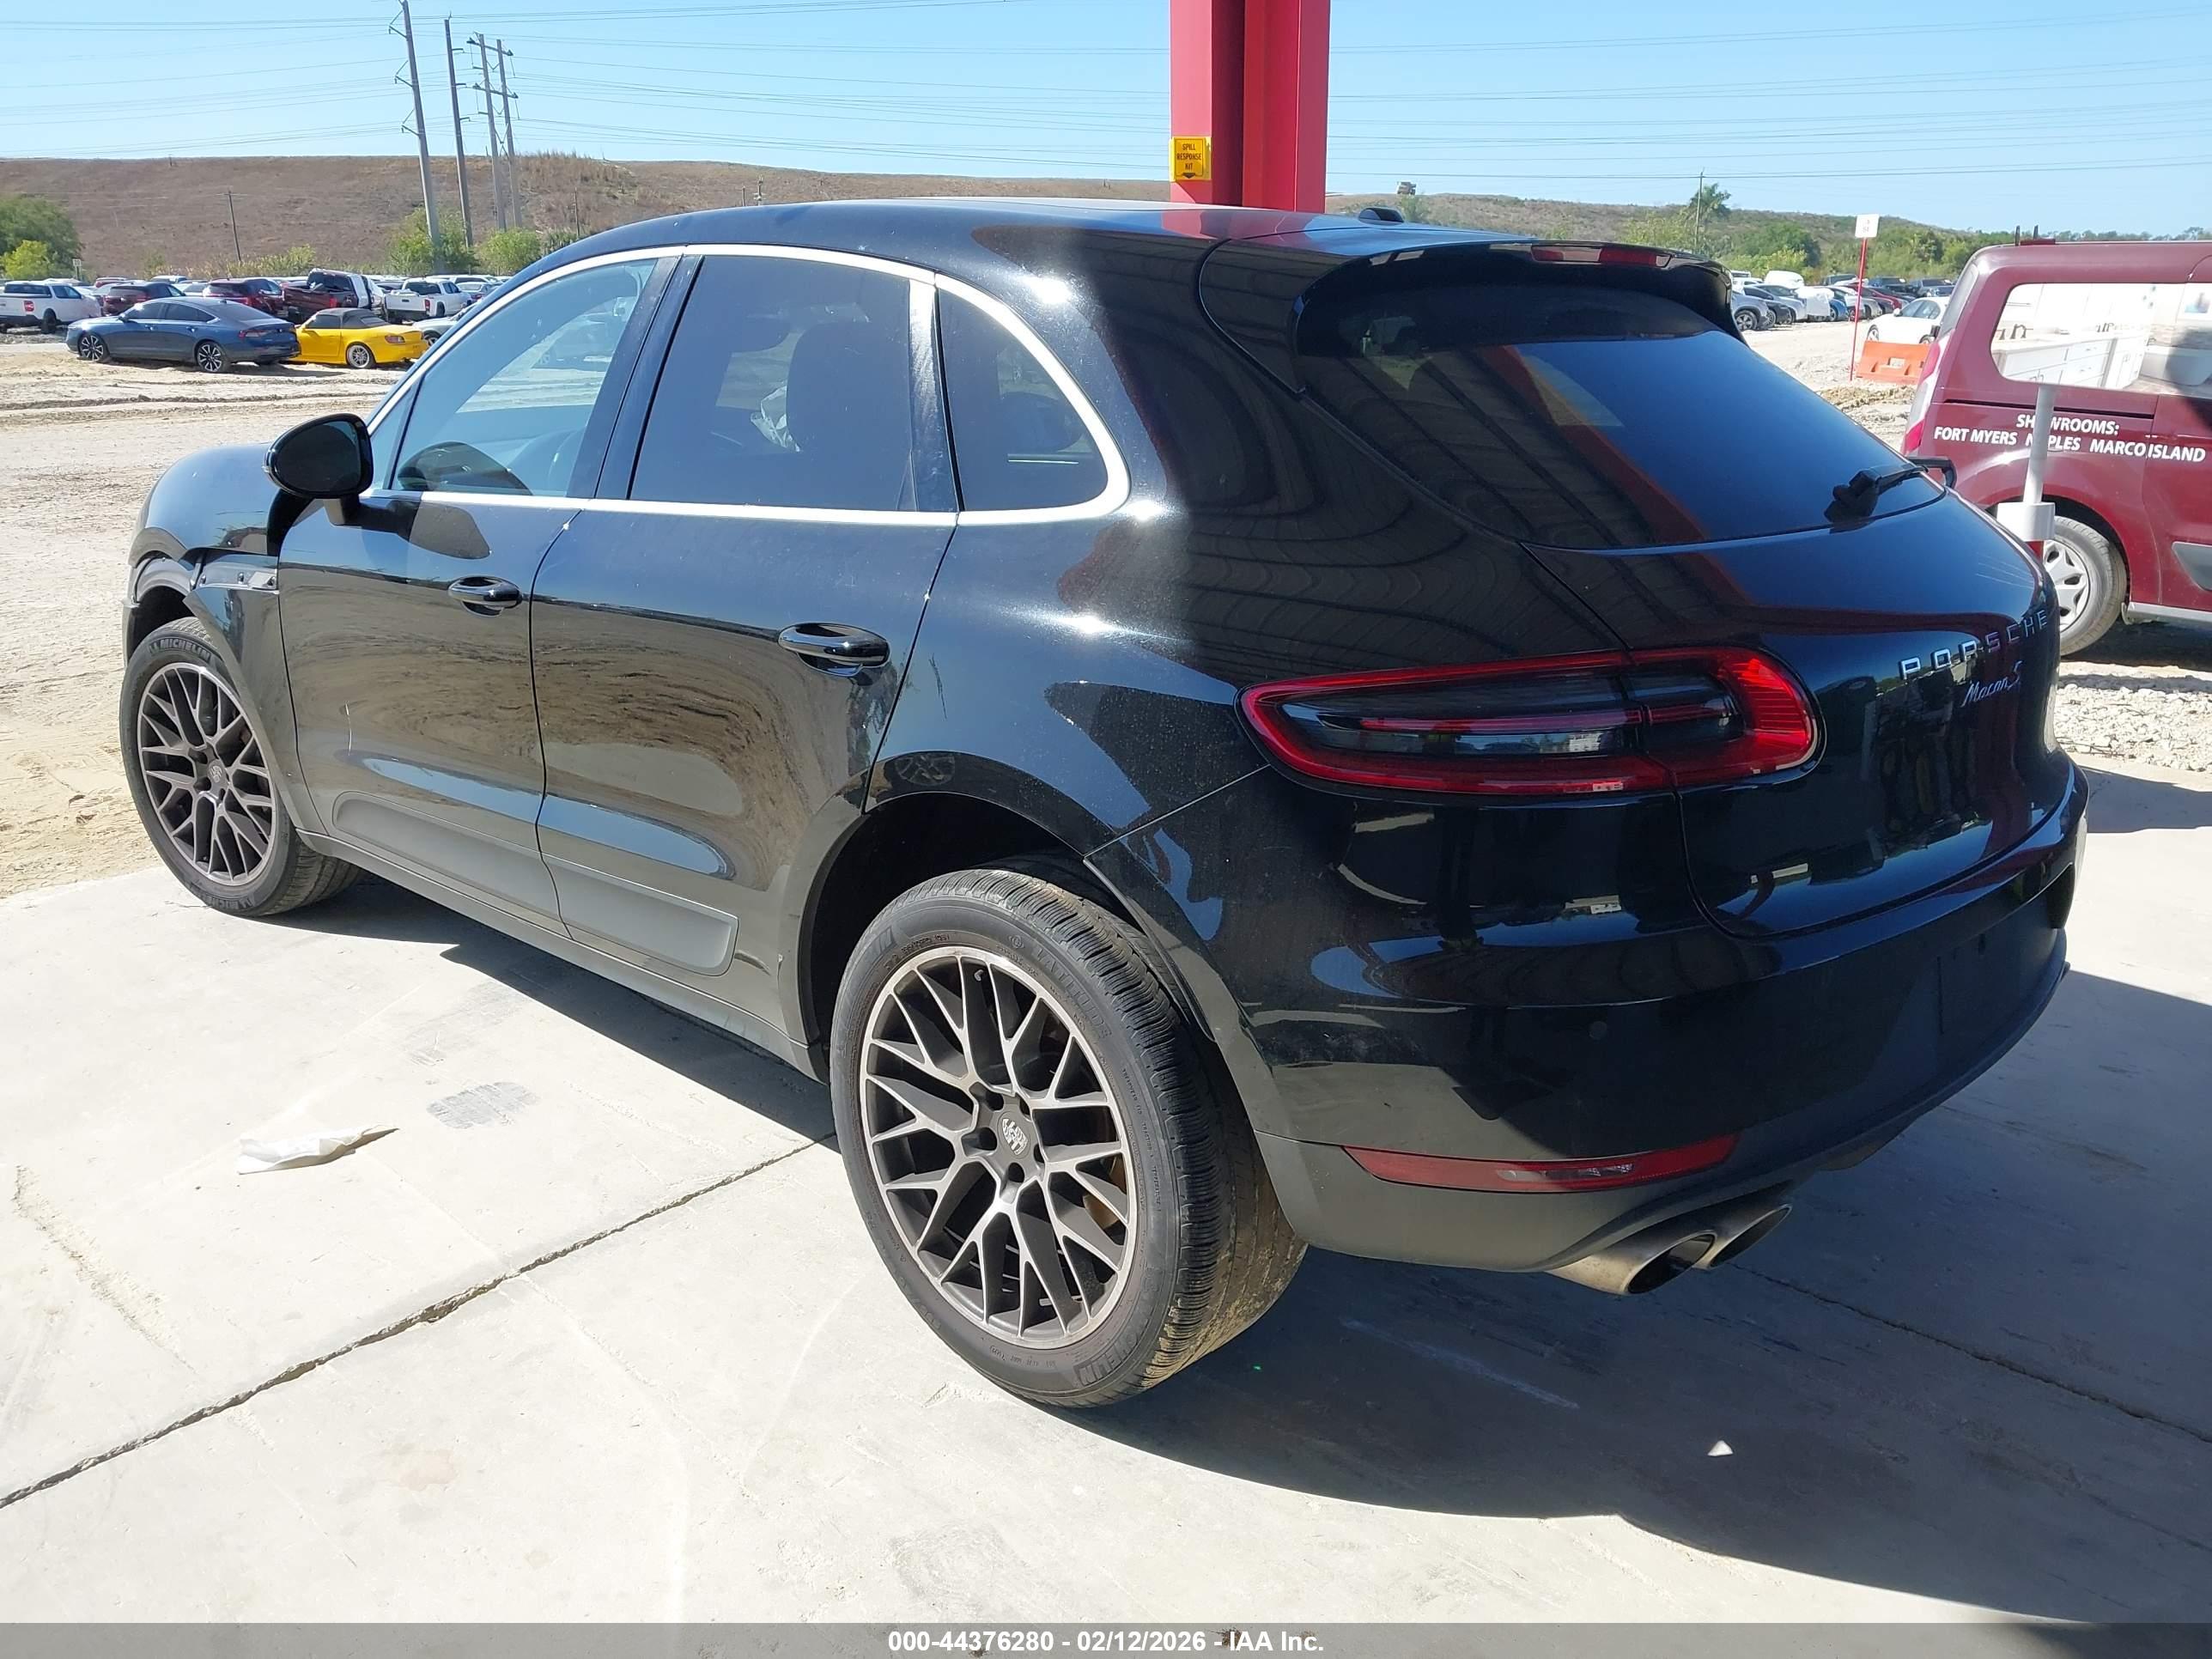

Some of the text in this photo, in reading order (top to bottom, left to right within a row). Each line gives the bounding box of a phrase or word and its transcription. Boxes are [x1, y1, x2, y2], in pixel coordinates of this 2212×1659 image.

[2016, 414, 2119, 435] SHWROOMS:
[1934, 427, 2206, 463] FORT MYERS NPLES MARCO ISLAND
[160, 638, 212, 663] MICHELIN
[1899, 611, 2048, 680] PORSCHE
[1960, 660, 2023, 708] Macan S
